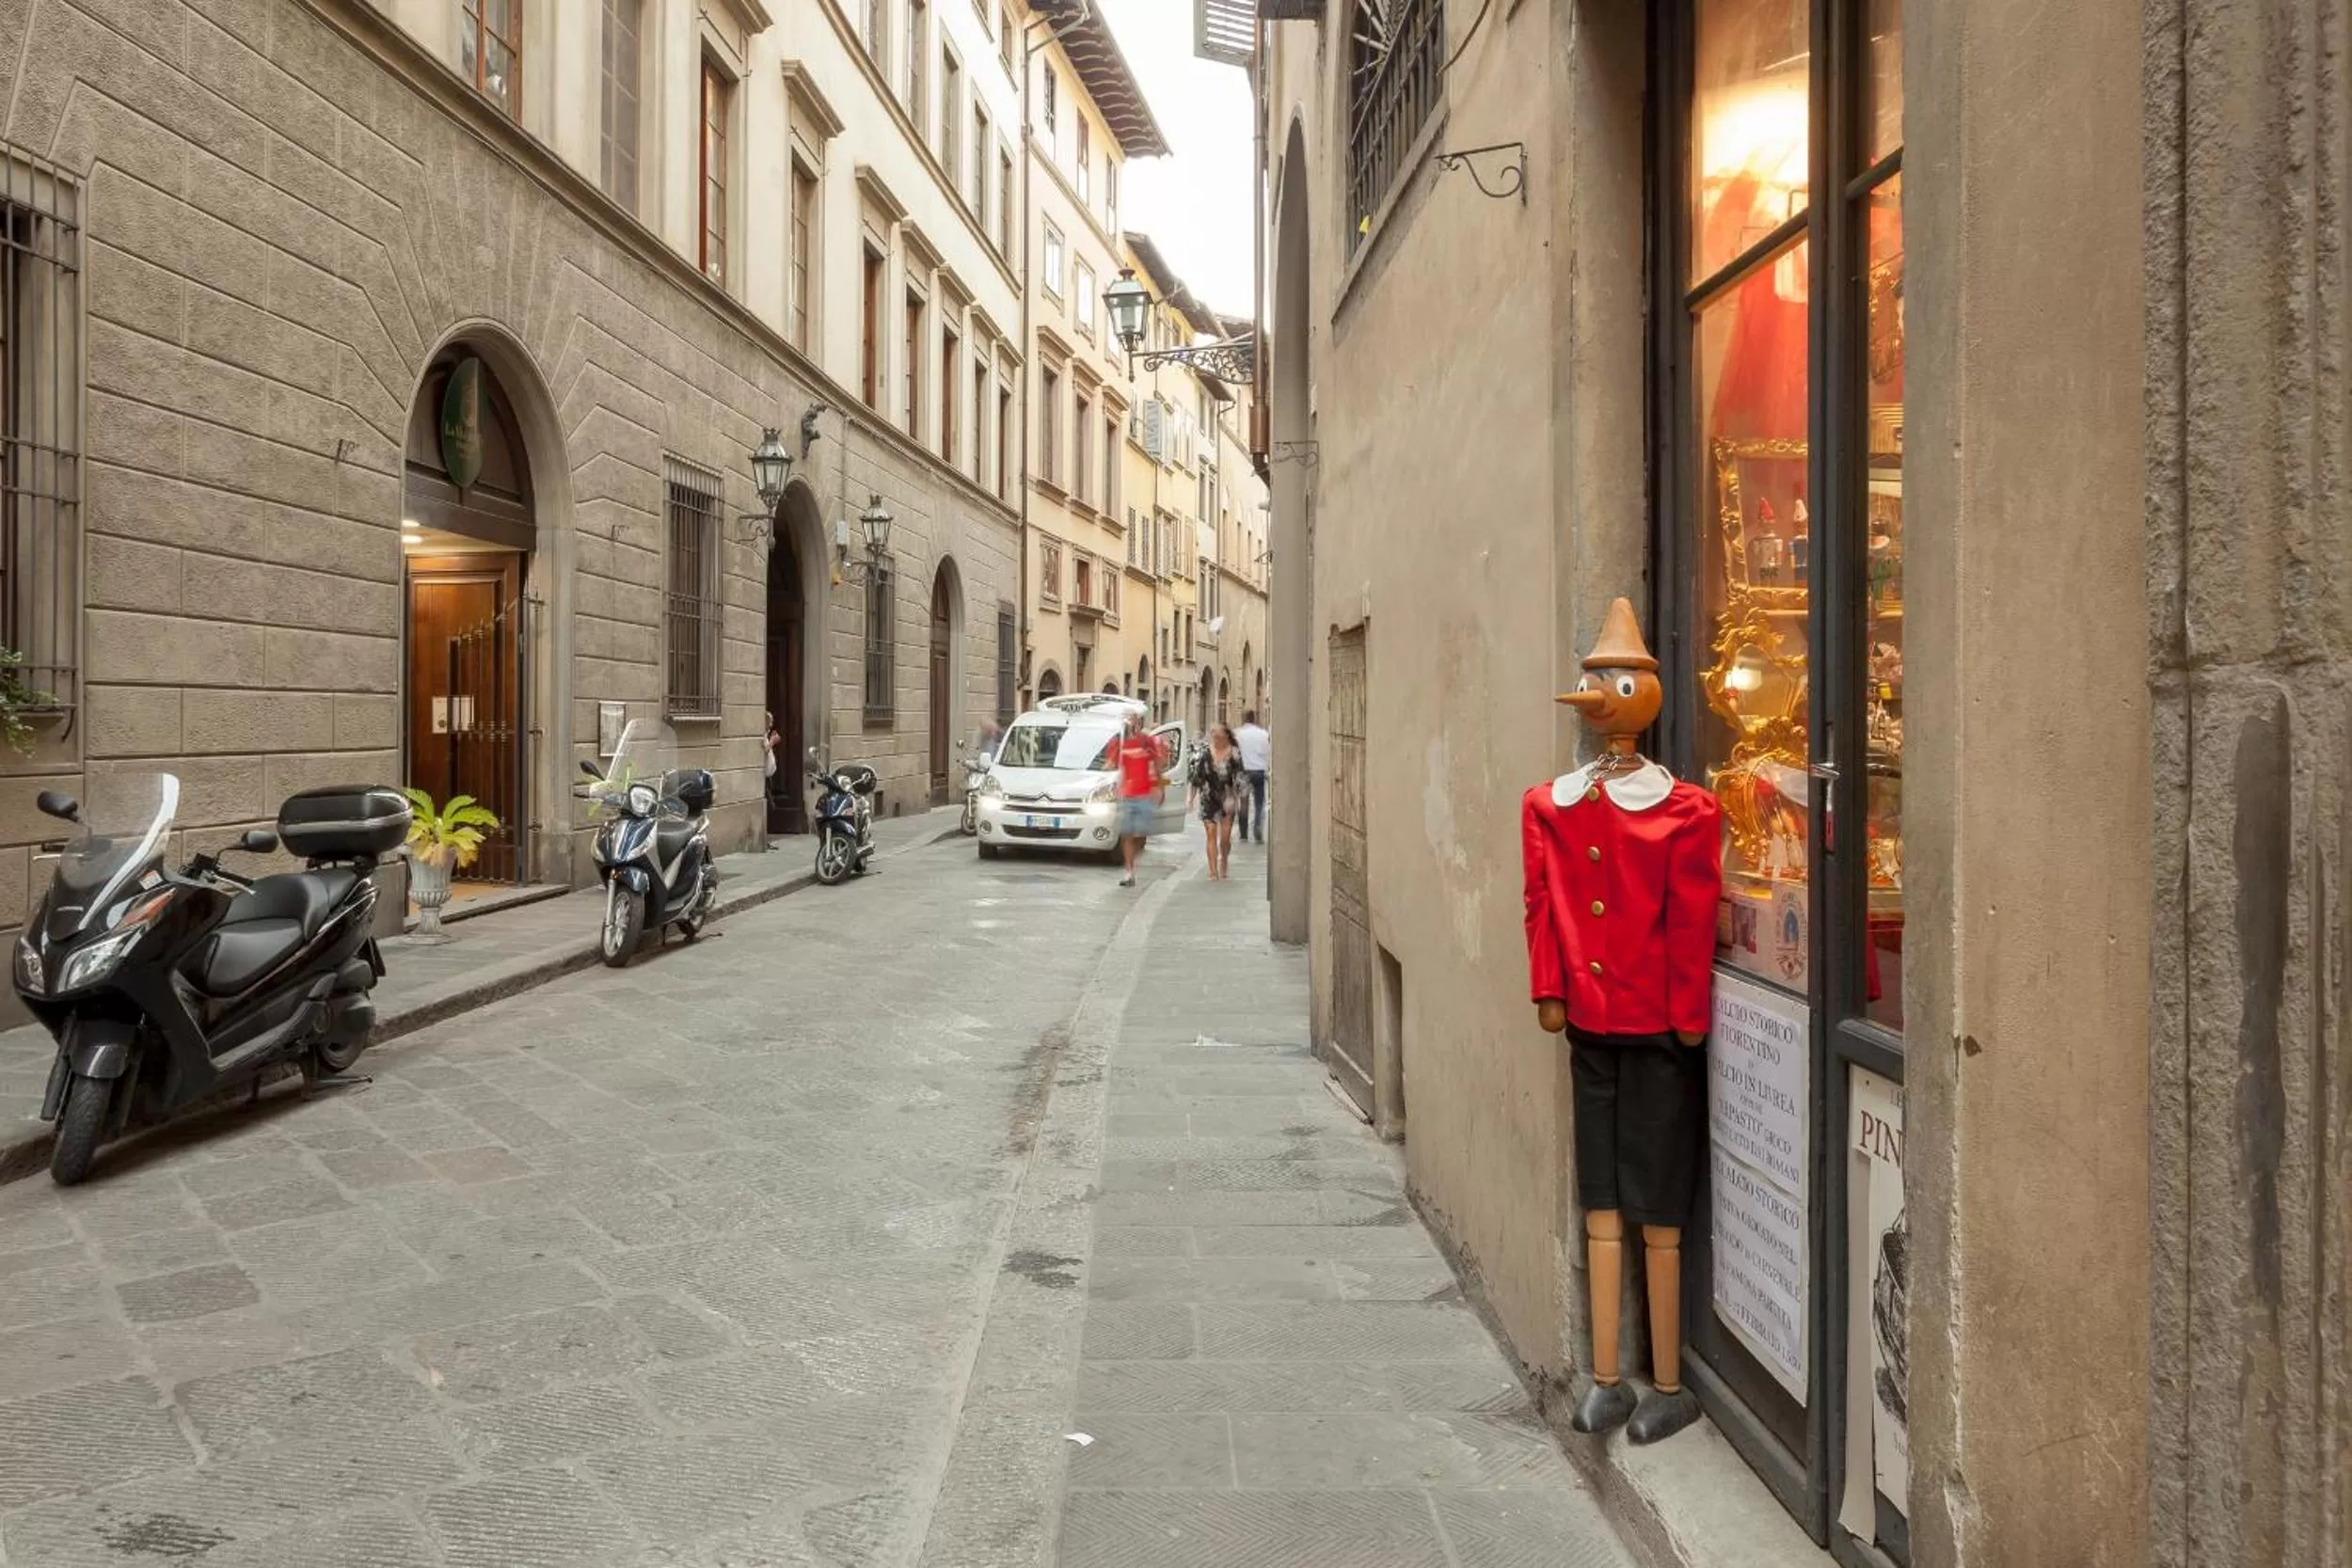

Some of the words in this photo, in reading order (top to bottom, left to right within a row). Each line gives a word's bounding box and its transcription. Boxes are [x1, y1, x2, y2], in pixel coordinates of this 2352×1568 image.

[1720, 1022, 1780, 1066] FIORENTINO
[1749, 1008, 1793, 1046] STORICO
[1744, 1072, 1755, 1095] IN
[1758, 1079, 1795, 1118] LIVREA
[1756, 1182, 1799, 1229] STORICO
